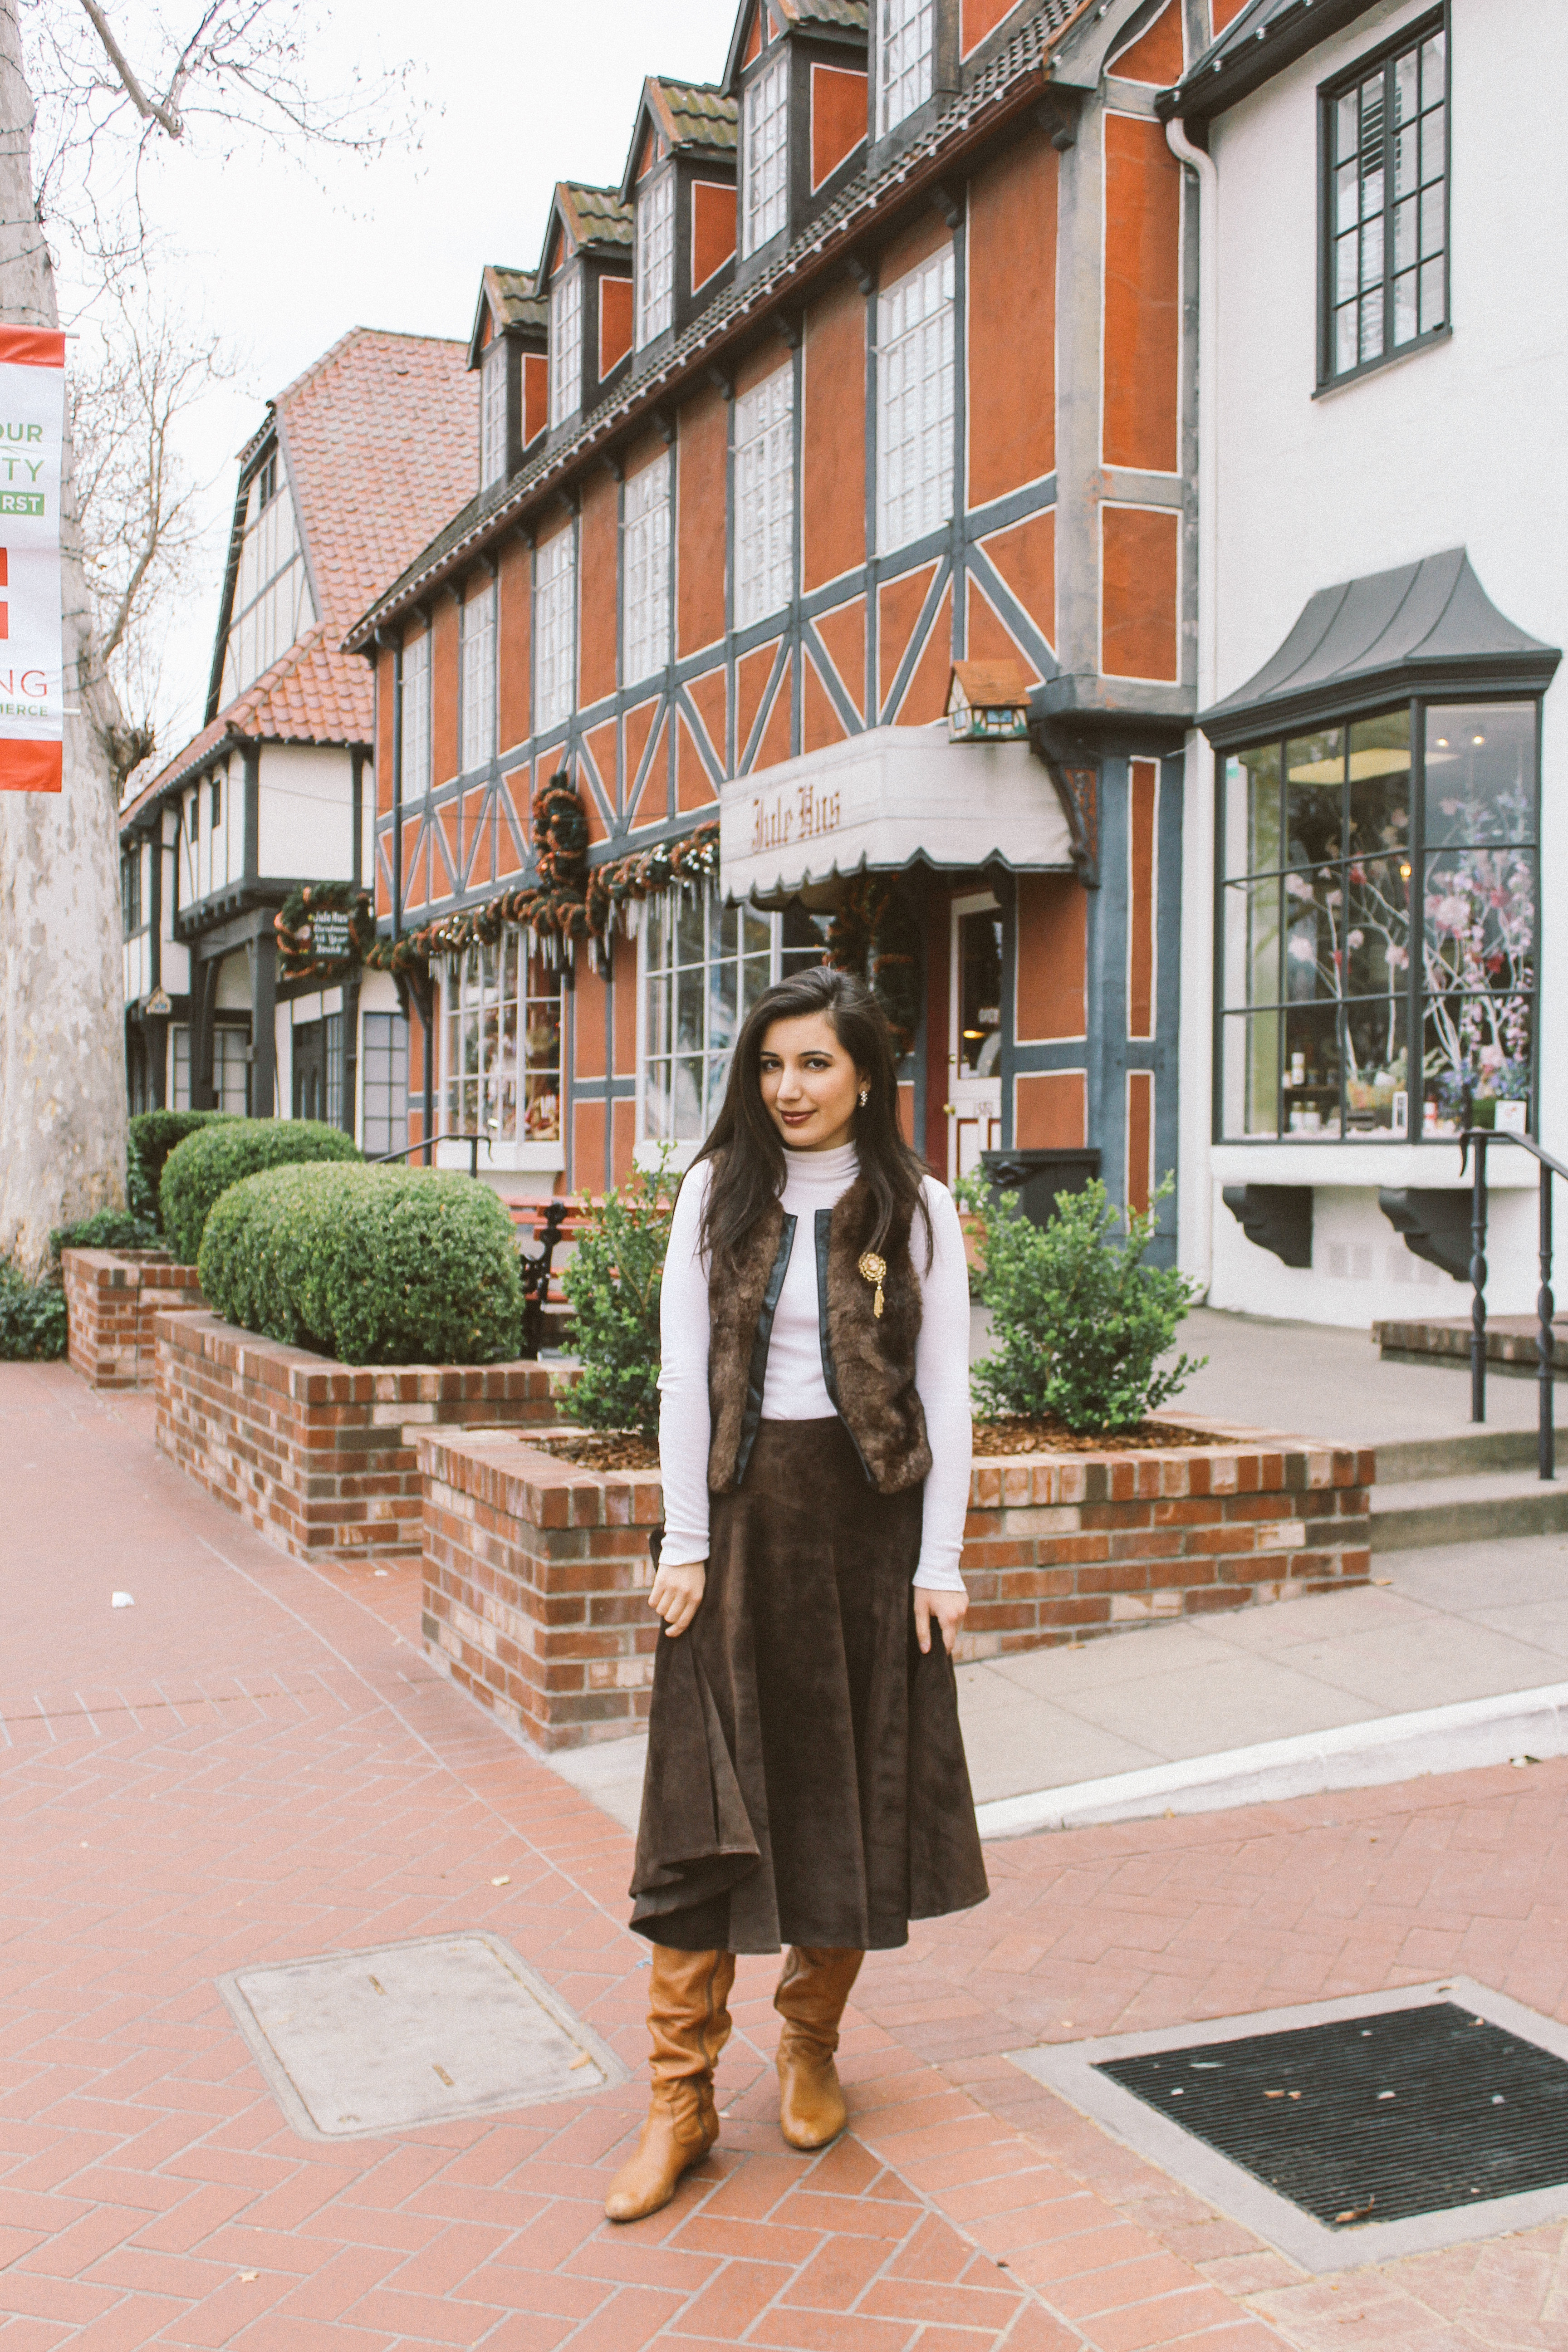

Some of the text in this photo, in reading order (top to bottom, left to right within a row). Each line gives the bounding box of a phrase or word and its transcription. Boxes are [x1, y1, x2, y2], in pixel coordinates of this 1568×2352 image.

[0, 422, 43, 443] UR
[2, 457, 44, 482] TY
[2, 495, 41, 512] RST
[0, 703, 48, 717] ERCE
[752, 784, 840, 853] Jule Hus
[314, 934, 325, 943] All
